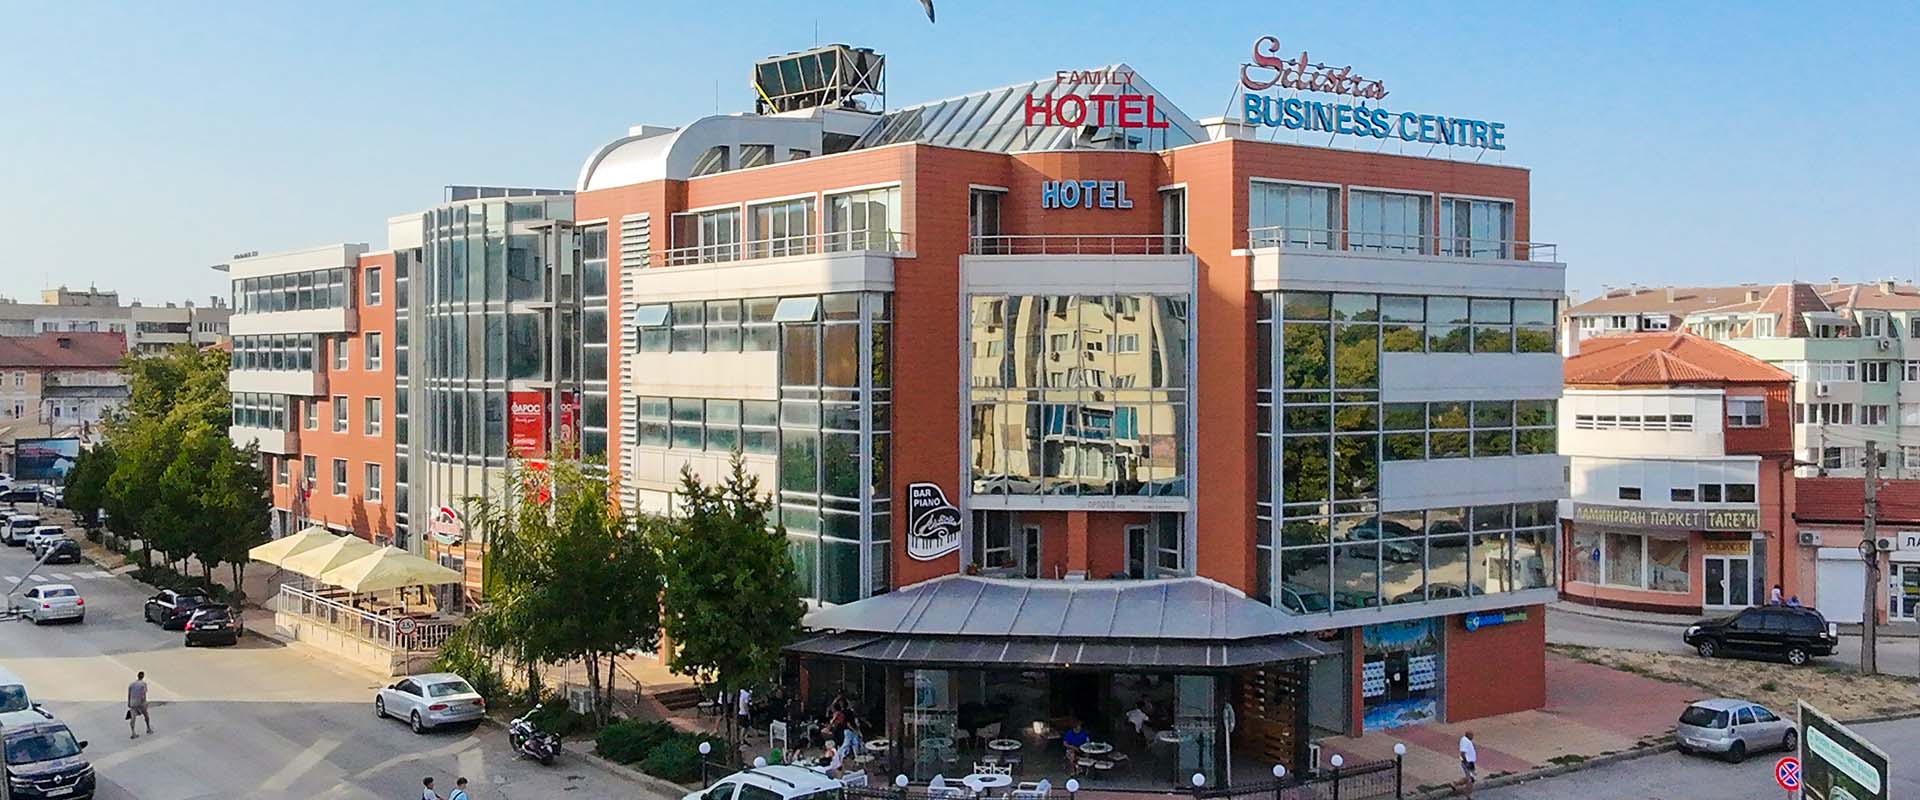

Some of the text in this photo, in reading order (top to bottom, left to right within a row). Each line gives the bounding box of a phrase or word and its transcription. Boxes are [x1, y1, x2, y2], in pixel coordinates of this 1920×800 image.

[1056, 71, 1135, 85] FAMILY
[1241, 36, 1390, 99] Silistra
[1025, 94, 1169, 128] HOTEL
[1243, 93, 1506, 150] BUSINESS CENTRE
[1042, 179, 1133, 209] HOTEL
[913, 489, 931, 497] BAR
[913, 498, 940, 507] PIANO
[1576, 507, 1700, 528] ЛАМИНИРАН ПАРКЕТ
